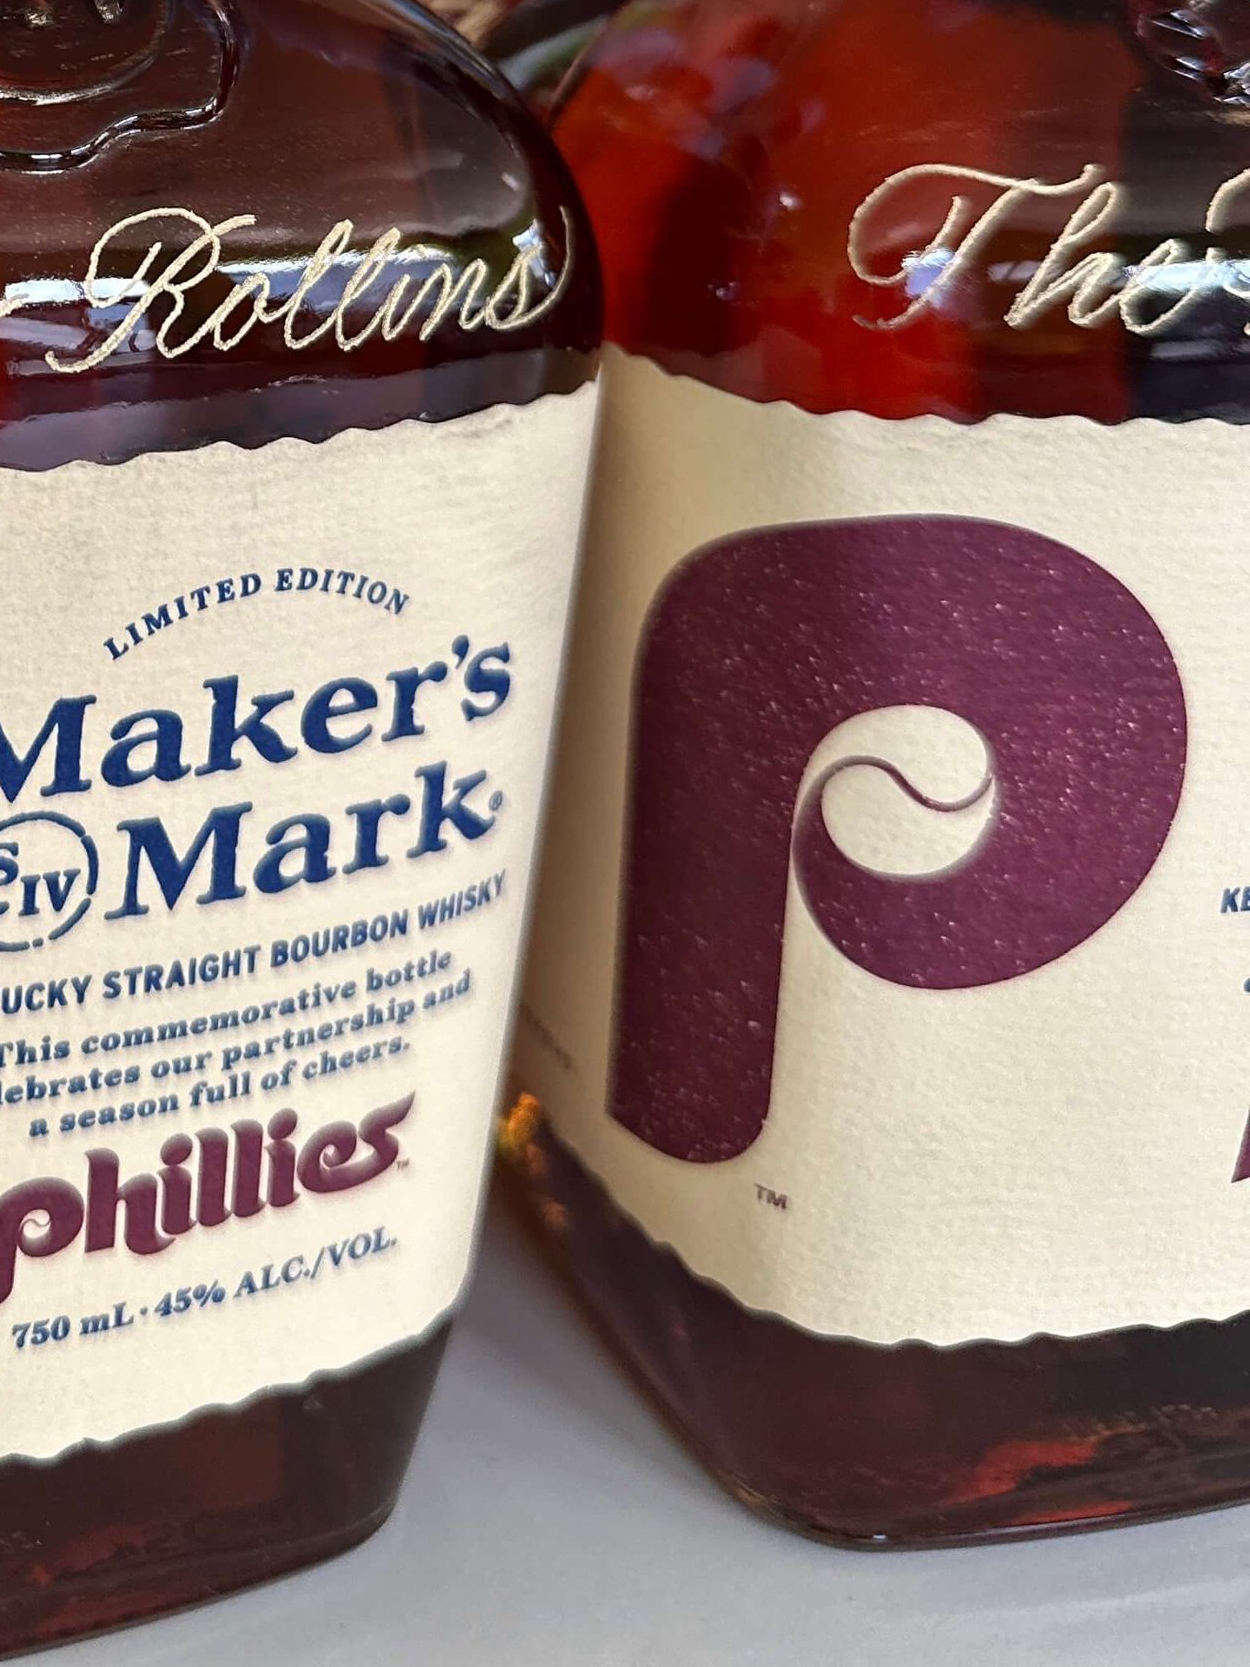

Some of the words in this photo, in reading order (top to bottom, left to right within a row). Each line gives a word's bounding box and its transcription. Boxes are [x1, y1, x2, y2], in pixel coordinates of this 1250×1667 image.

[45, 205, 572, 373] Rollins
[103, 571, 262, 661] LIMITED
[274, 567, 411, 617] EDITION
[100, 944, 262, 1000] STRAIGHT
[269, 911, 409, 969] BOURBON
[416, 867, 507, 929] WHISKY
[79, 981, 356, 1056] commemorative
[365, 948, 454, 994] bottle
[149, 1049, 215, 1081] our
[220, 998, 417, 1073] partnership
[421, 967, 474, 1013] and
[27, 1115, 50, 1138] a
[58, 1095, 181, 1133] season
[188, 1069, 253, 1109] full
[259, 1061, 298, 1093] of
[300, 1037, 412, 1082] cheers.
[10, 1313, 71, 1350] 750
[78, 1302, 136, 1338] mL
[231, 1224, 400, 1300] ALC./VOL.
